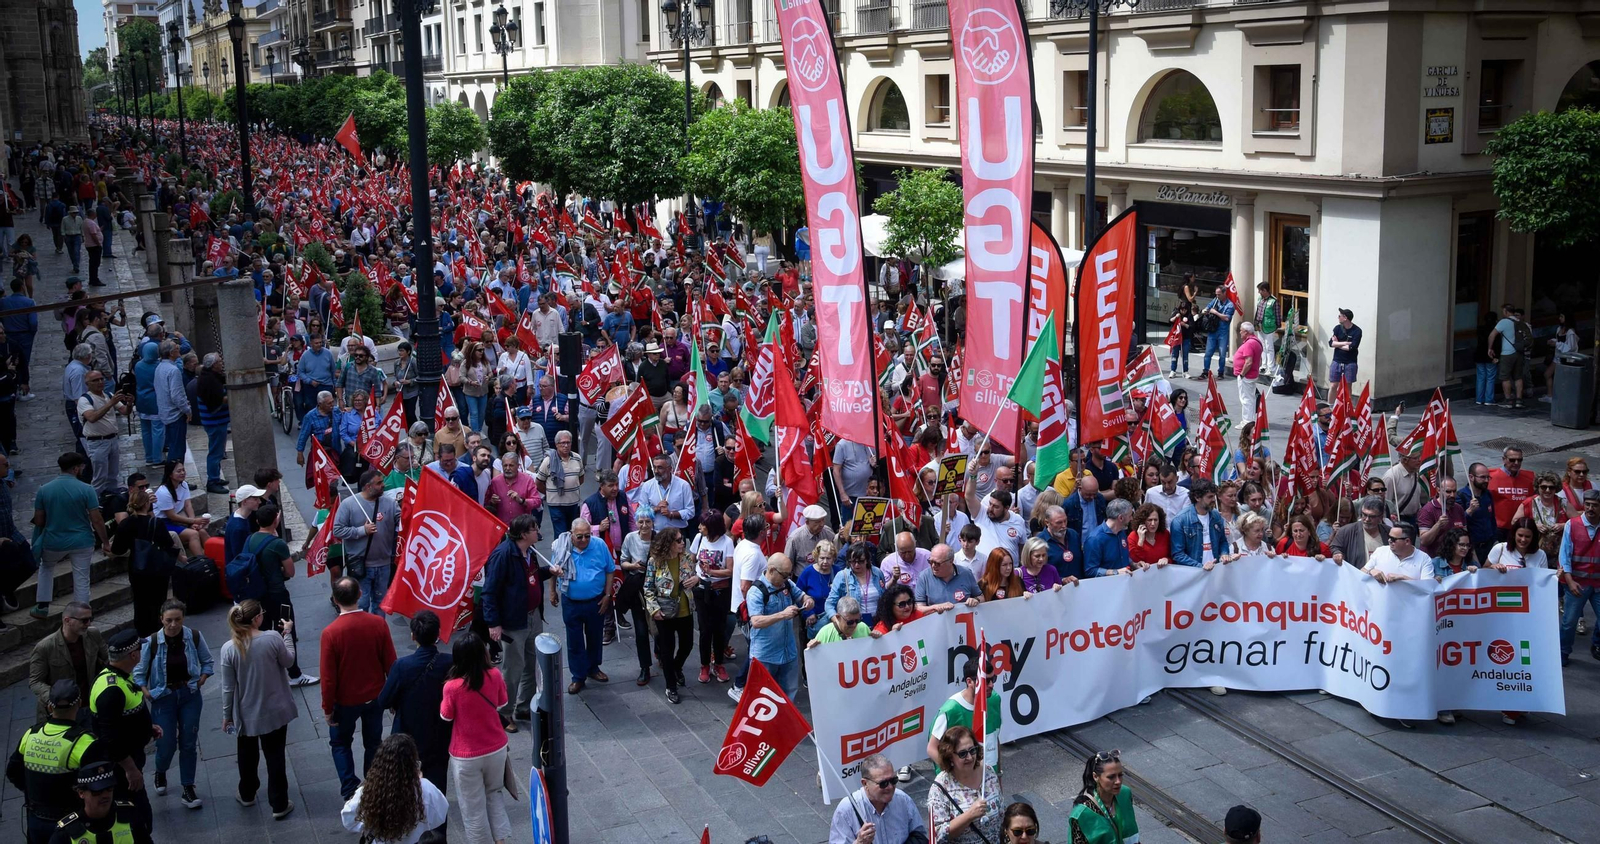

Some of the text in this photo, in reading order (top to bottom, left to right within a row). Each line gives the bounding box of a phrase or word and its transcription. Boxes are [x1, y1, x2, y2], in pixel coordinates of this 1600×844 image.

[1427, 66, 1458, 76] GARCIA
[1437, 77, 1448, 86] DE
[1424, 87, 1460, 97] VINUESA
[1155, 185, 1229, 206] La Canasta
[1095, 249, 1121, 381] CCOO
[1102, 413, 1127, 429] Sevill
[1497, 487, 1524, 495] CCOO
[1436, 592, 1492, 615] CCOO
[1046, 595, 1392, 660] Proteger lo conquistado,
[1163, 630, 1391, 691] ganar futuro
[838, 652, 897, 689] UGT
[1471, 669, 1532, 681] Andalucía
[888, 671, 928, 695] Andalucía
[904, 683, 926, 699] Sevilla
[1496, 682, 1533, 692] Sevilla
[846, 721, 900, 758] CCOO
[26, 750, 60, 762] SEVILLA
[30, 745, 57, 754] LOCAL
[841, 762, 862, 779] Sevi
